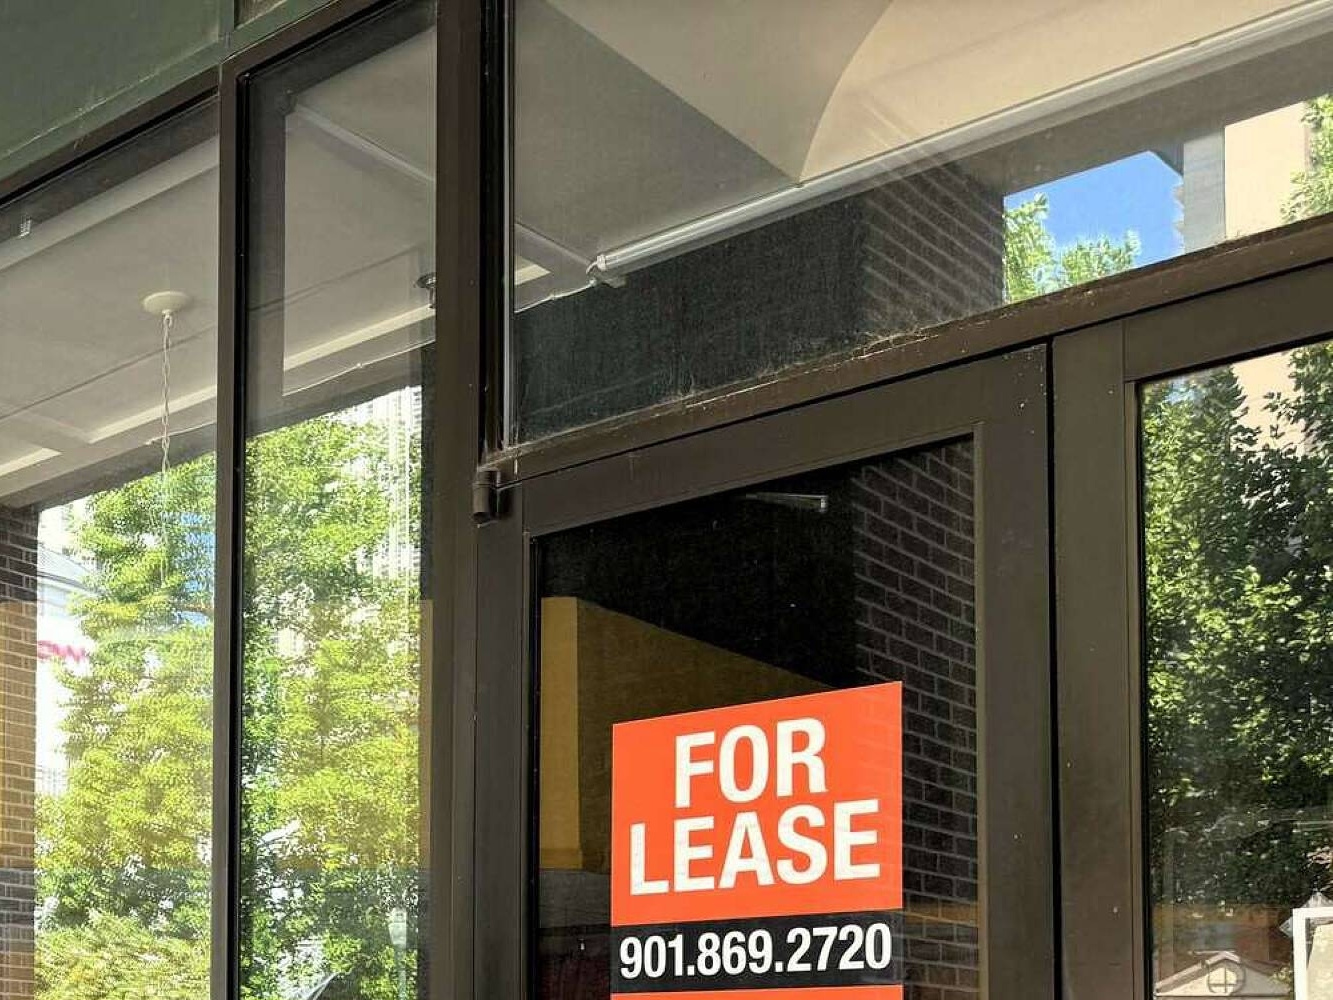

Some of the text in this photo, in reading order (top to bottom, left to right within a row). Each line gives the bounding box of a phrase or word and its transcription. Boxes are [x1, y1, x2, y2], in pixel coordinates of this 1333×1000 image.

[674, 717, 829, 808] FOR
[629, 798, 881, 896] LEASE
[619, 922, 892, 979] 901.869.2720
